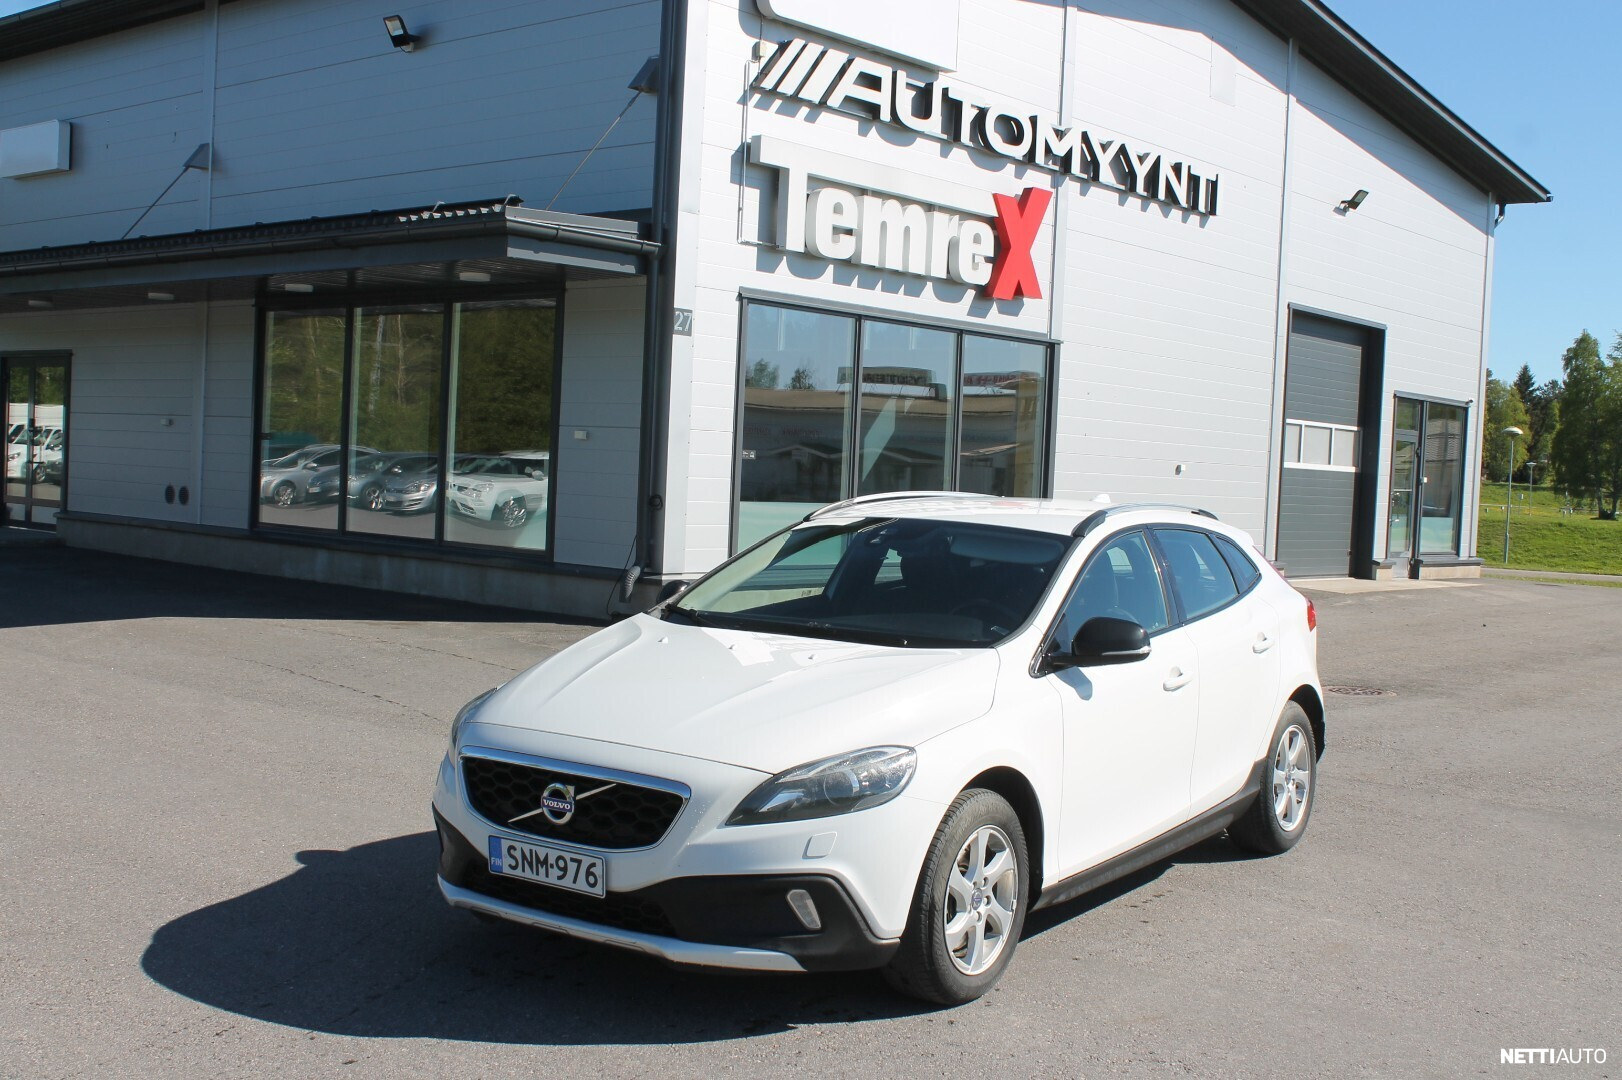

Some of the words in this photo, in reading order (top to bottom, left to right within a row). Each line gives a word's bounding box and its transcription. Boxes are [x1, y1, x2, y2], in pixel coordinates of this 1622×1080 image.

[674, 311, 692, 331] 27
[543, 799, 570, 809] VOLVO
[507, 845, 598, 888] SNM-976
